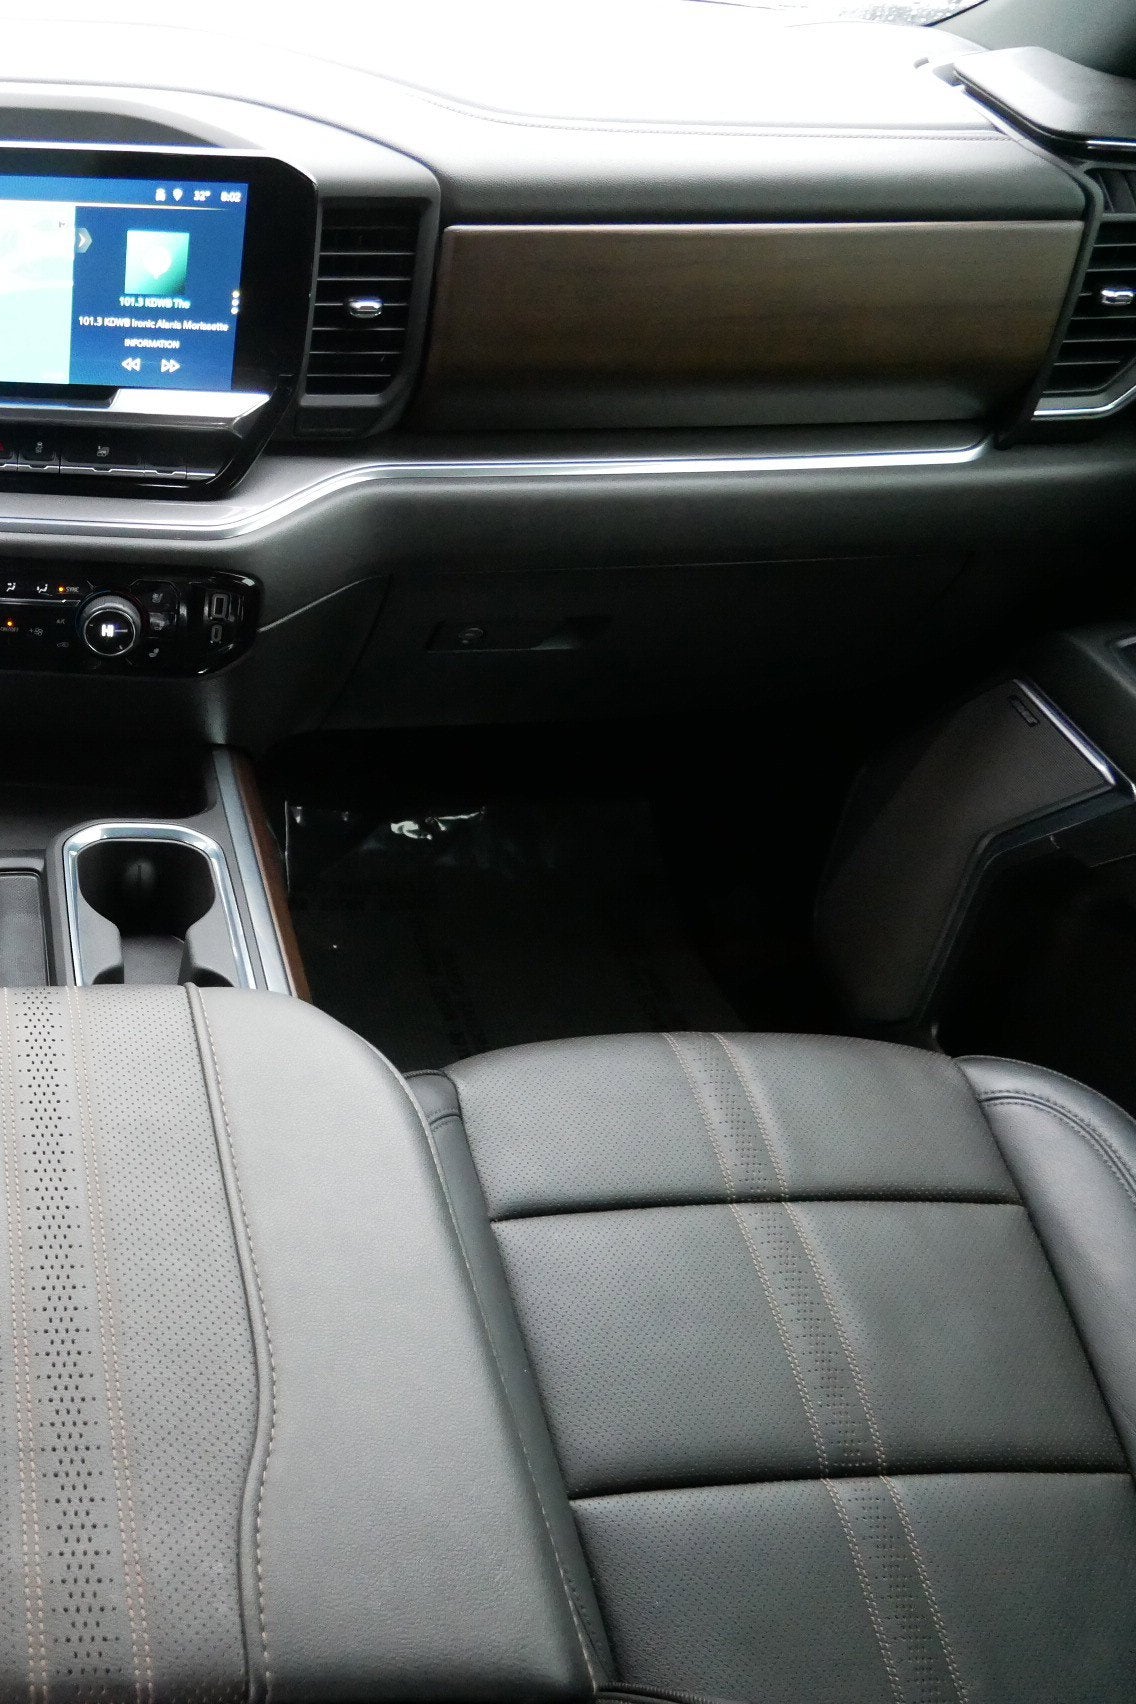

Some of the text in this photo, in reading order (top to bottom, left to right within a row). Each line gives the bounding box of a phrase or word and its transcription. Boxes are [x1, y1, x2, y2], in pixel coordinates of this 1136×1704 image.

[119, 297, 144, 308] 101.3
[174, 299, 191, 309] The
[79, 316, 103, 327] 101.3
[124, 338, 180, 349] INFORMATION
[101, 624, 115, 637] HI
